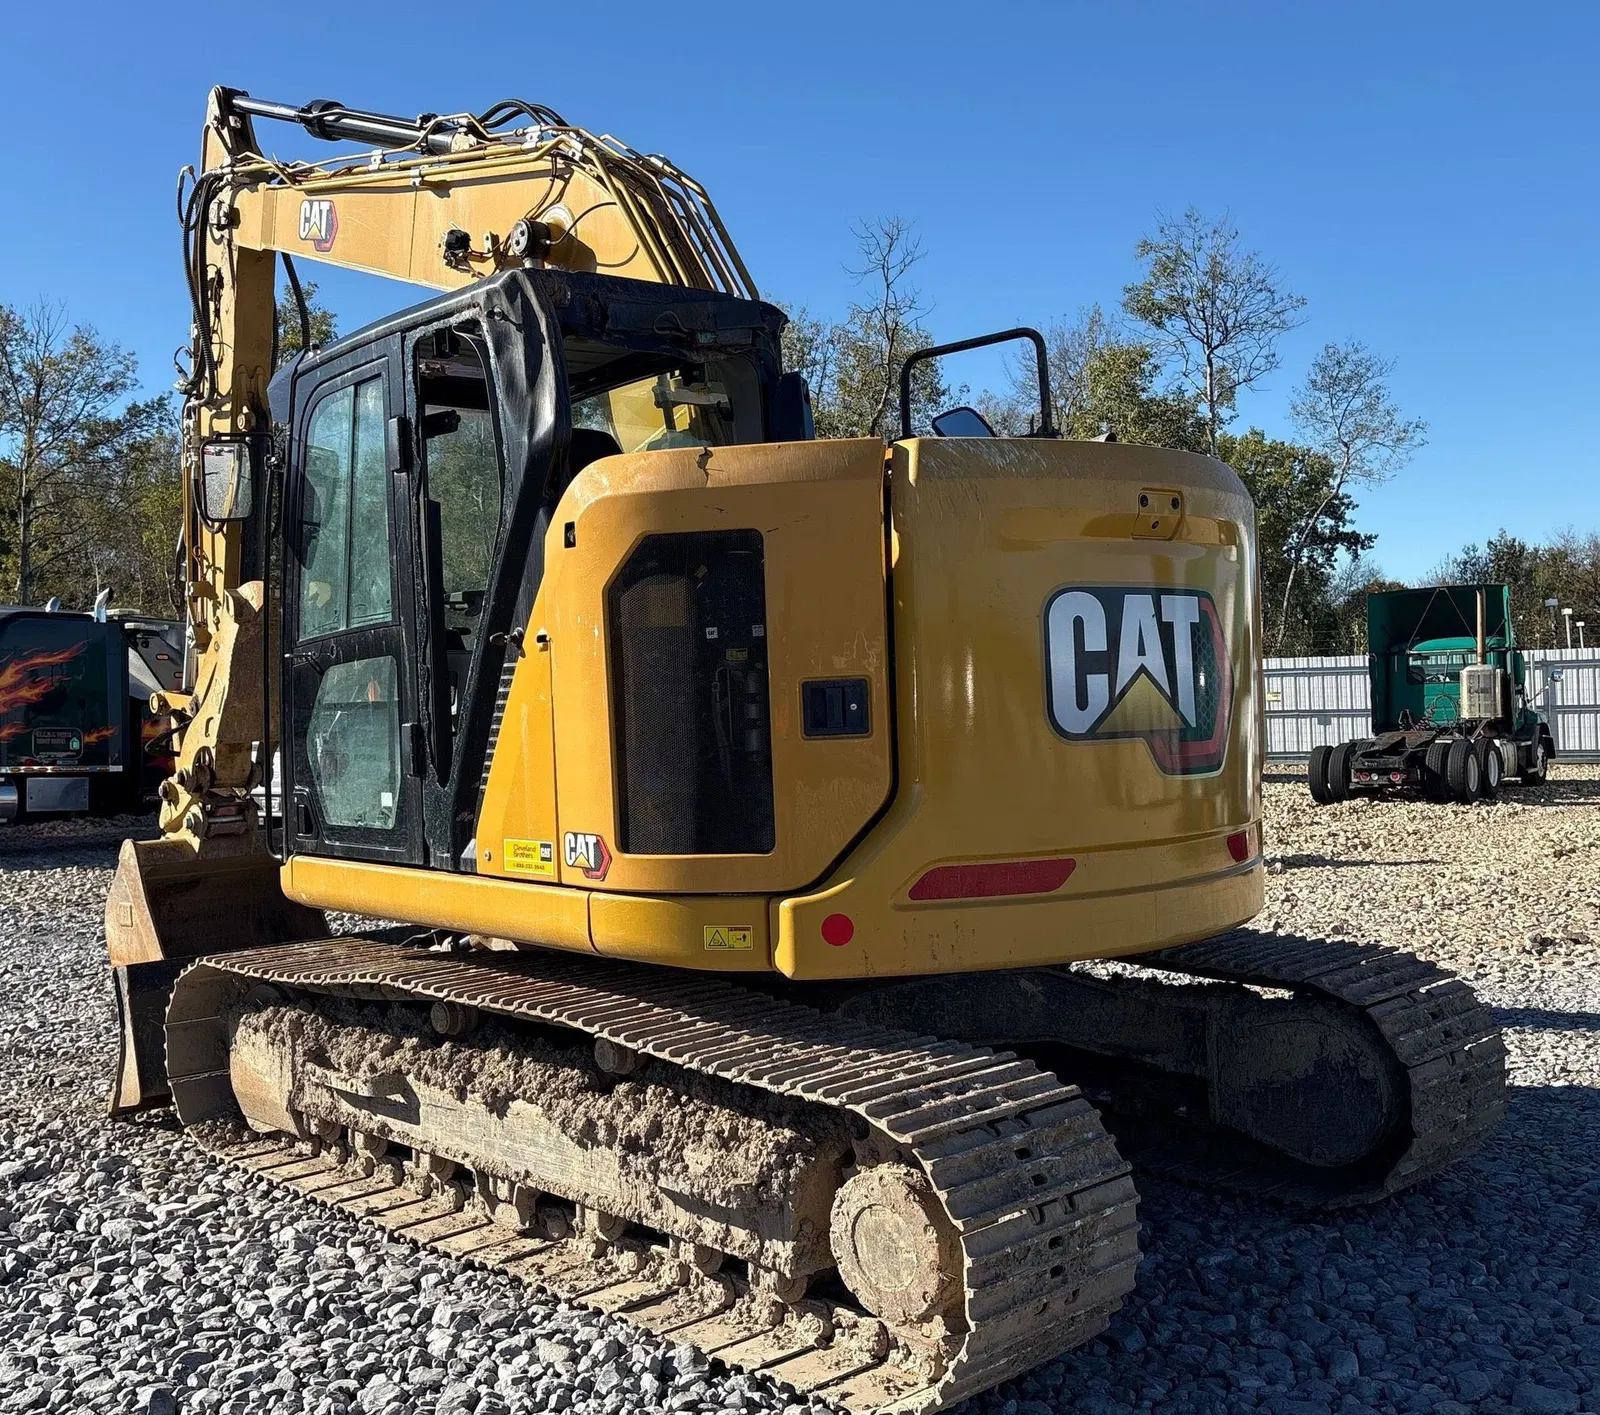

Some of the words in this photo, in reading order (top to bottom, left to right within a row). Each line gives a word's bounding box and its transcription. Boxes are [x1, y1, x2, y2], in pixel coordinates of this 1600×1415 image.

[300, 200, 331, 240] CAT
[1048, 591, 1200, 734] CAT
[540, 847, 551, 858] CAT
[565, 832, 597, 869] CAT
